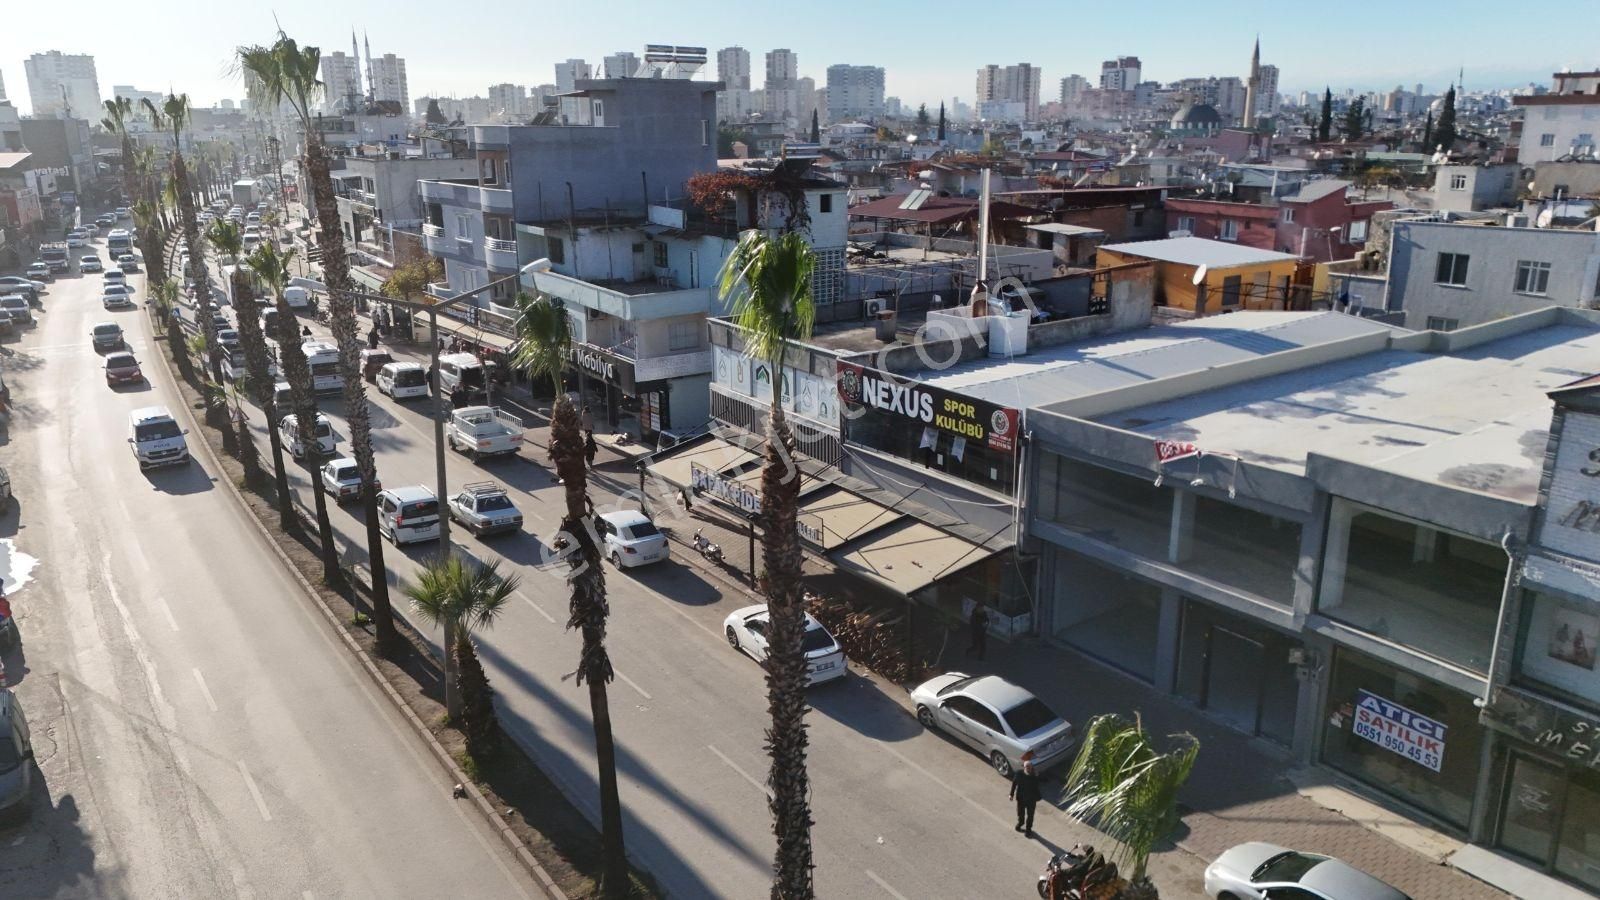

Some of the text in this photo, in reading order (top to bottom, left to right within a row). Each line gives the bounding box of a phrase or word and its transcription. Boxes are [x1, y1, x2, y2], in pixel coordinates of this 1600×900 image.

[577, 348, 613, 380] Mobilya
[862, 375, 934, 423] NEXUS
[943, 398, 976, 419] SPOR
[935, 414, 984, 440] KULÜBÜ
[1359, 709, 1440, 755] SATILIK
[1361, 696, 1445, 740] ATICI
[1356, 722, 1438, 769] 0551 950 45 53
